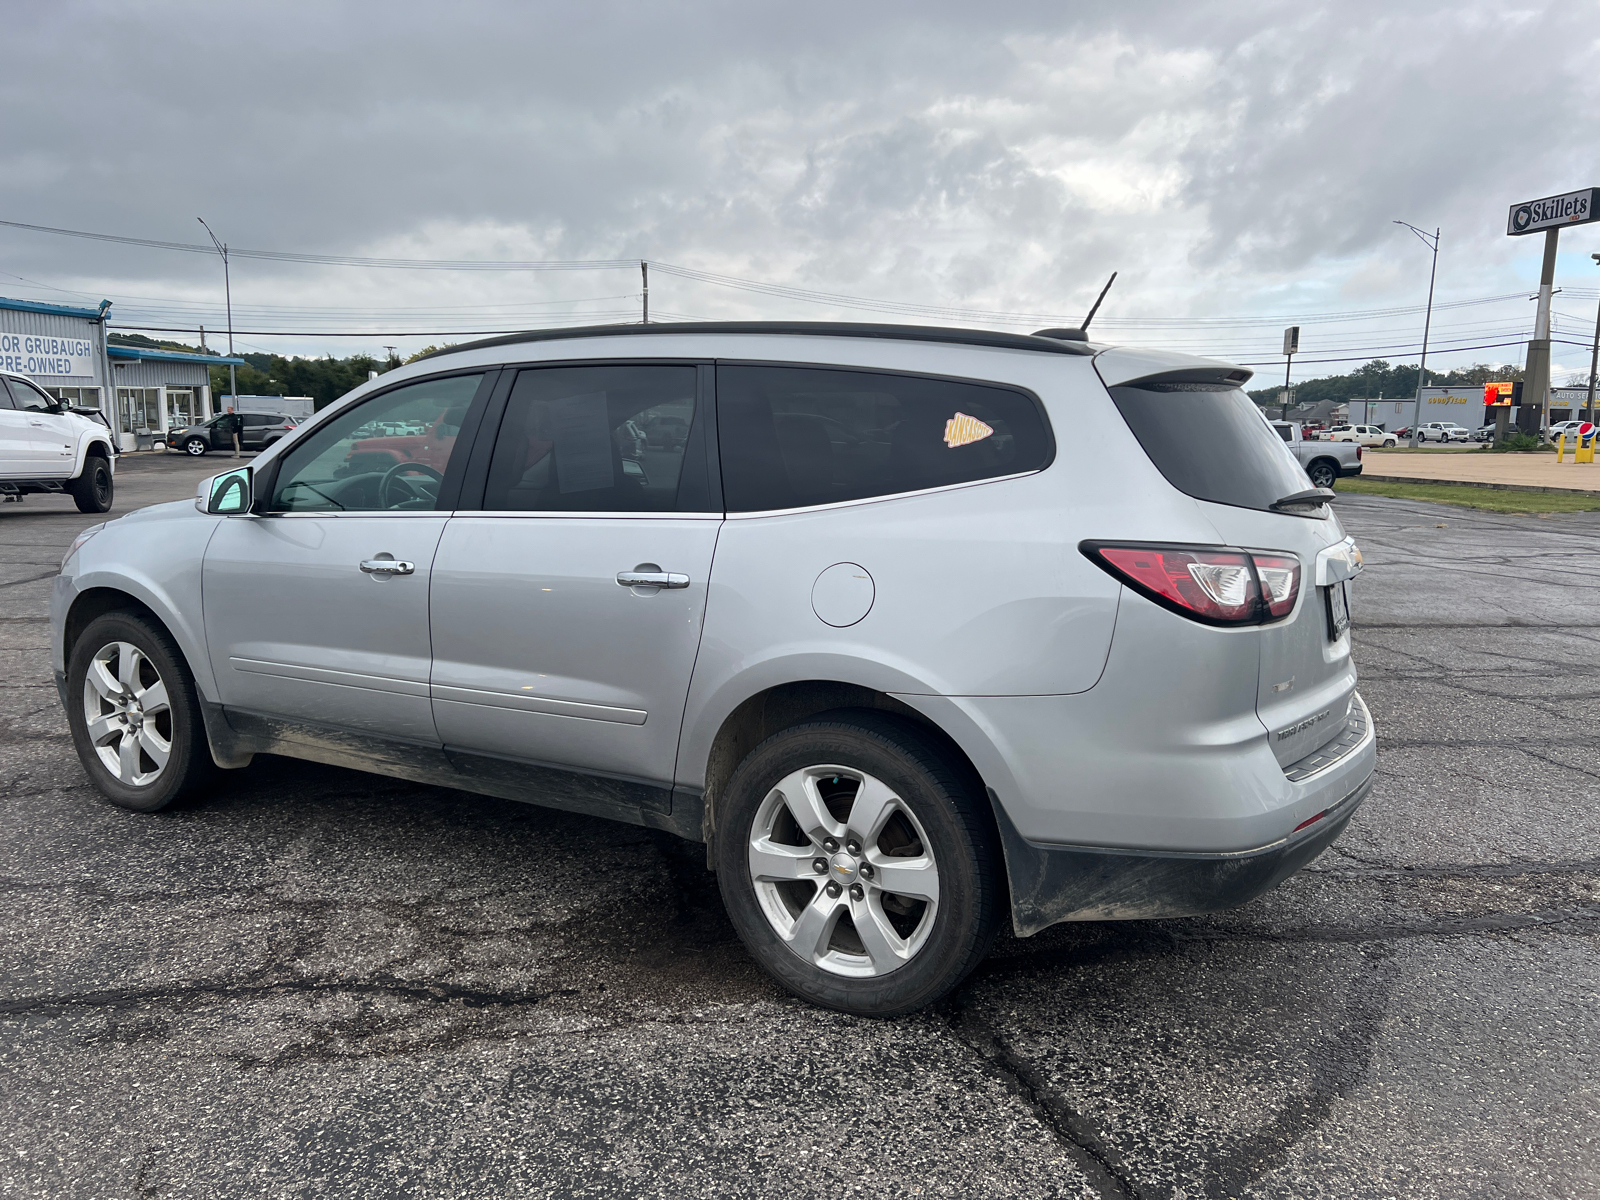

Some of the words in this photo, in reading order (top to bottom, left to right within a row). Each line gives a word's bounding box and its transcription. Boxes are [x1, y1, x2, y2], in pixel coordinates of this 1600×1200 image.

[1532, 197, 1587, 223] Skillets
[0, 335, 21, 353] OR
[25, 337, 91, 357] GRUBAUGH
[0, 355, 71, 374] PRE-OWNED
[1428, 396, 1467, 406] GOODYEAR
